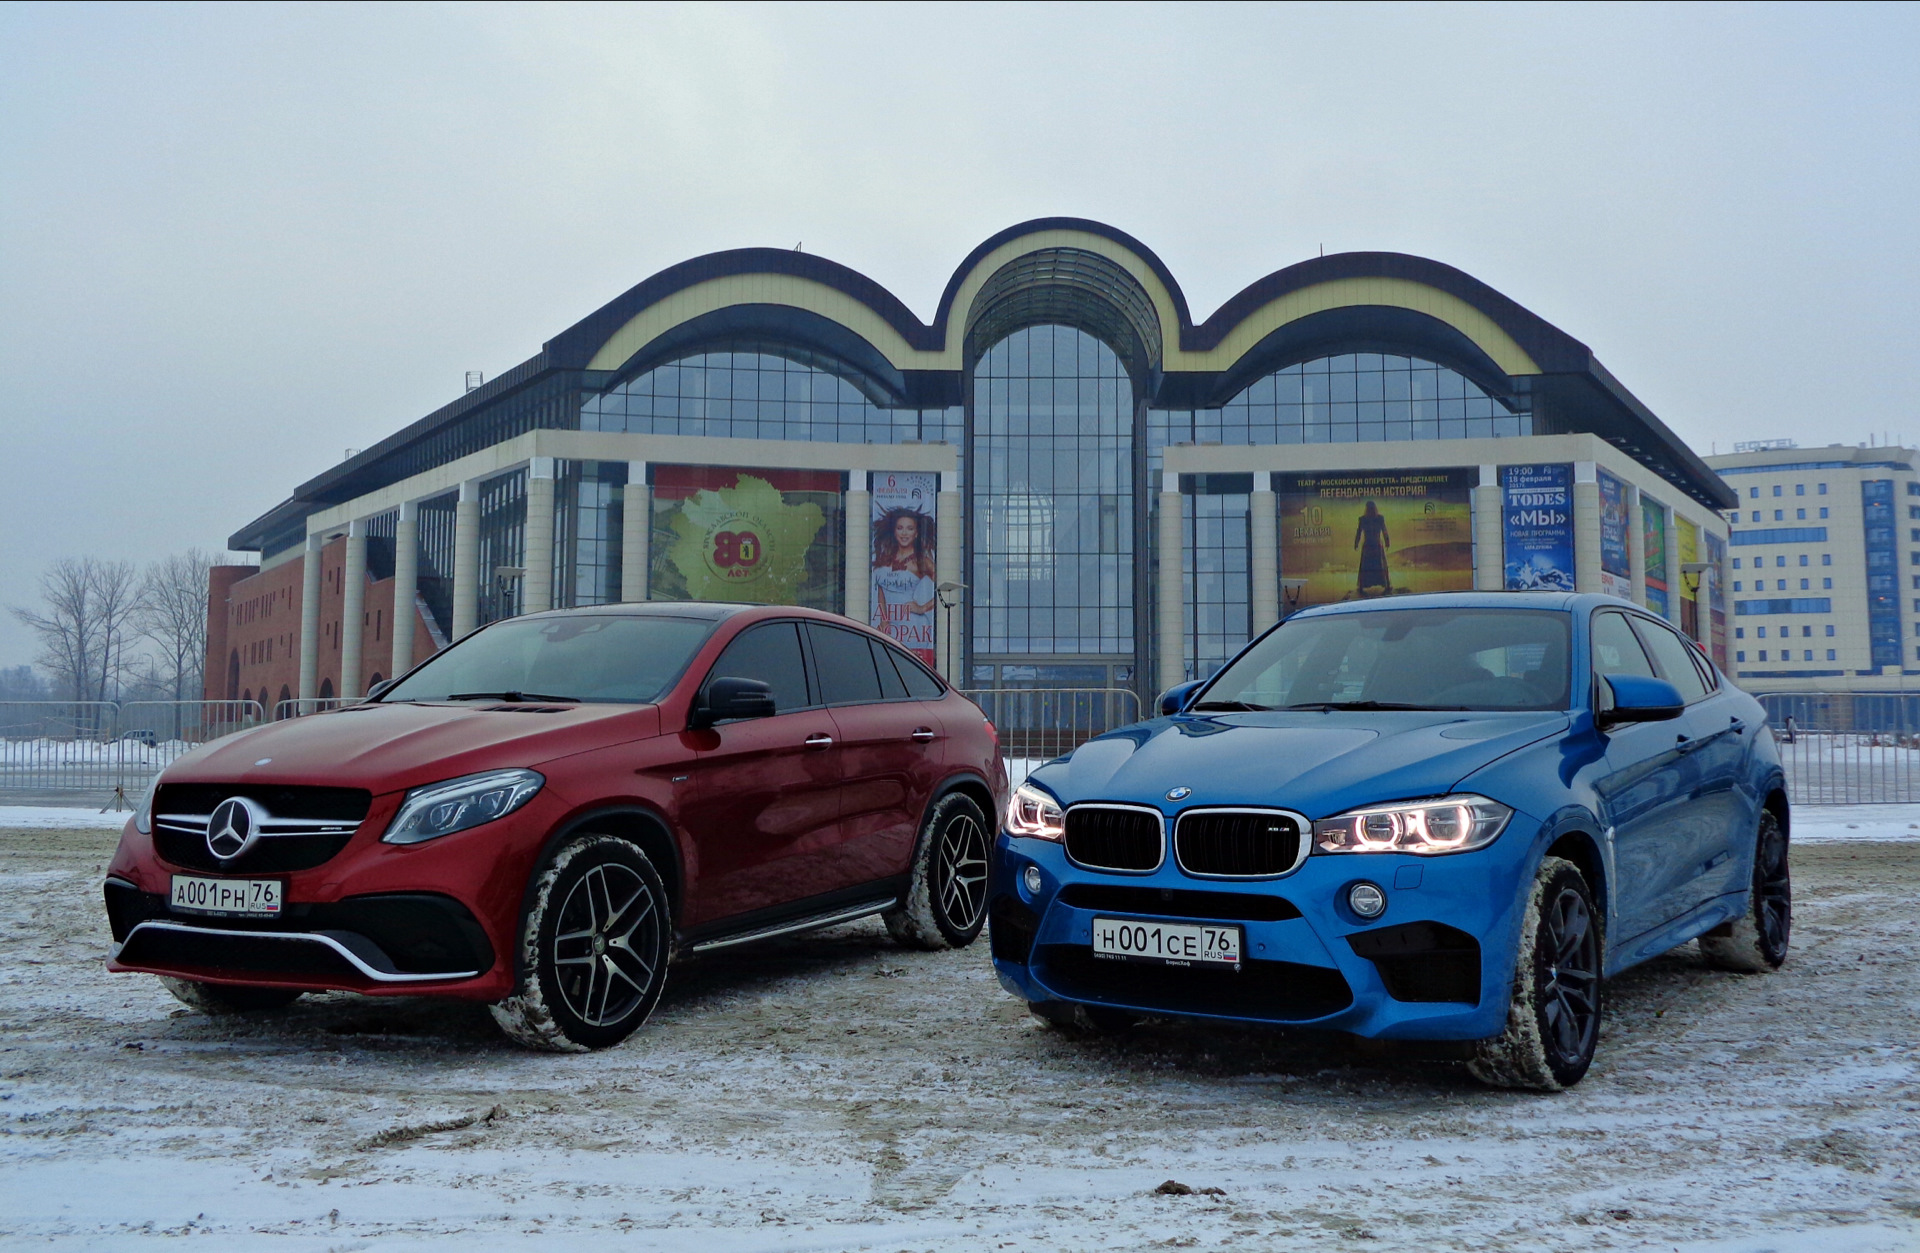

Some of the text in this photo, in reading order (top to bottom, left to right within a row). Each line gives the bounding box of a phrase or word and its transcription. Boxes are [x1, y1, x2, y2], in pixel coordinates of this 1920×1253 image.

[1509, 467, 1533, 475] 19:00
[887, 474, 896, 488] 6
[1320, 485, 1427, 498] ЛЕГЕНДАРНАЯ ИСТОРИЯ!
[1509, 493, 1566, 507] TODES
[1300, 505, 1323, 526] 10
[1510, 509, 1566, 526] «МЫ»
[713, 531, 761, 568] 80
[872, 603, 910, 621] АНИ
[252, 883, 274, 902] 76
[251, 902, 266, 910] RUS
[1204, 930, 1230, 951] 76
[1204, 951, 1222, 960] RUS
